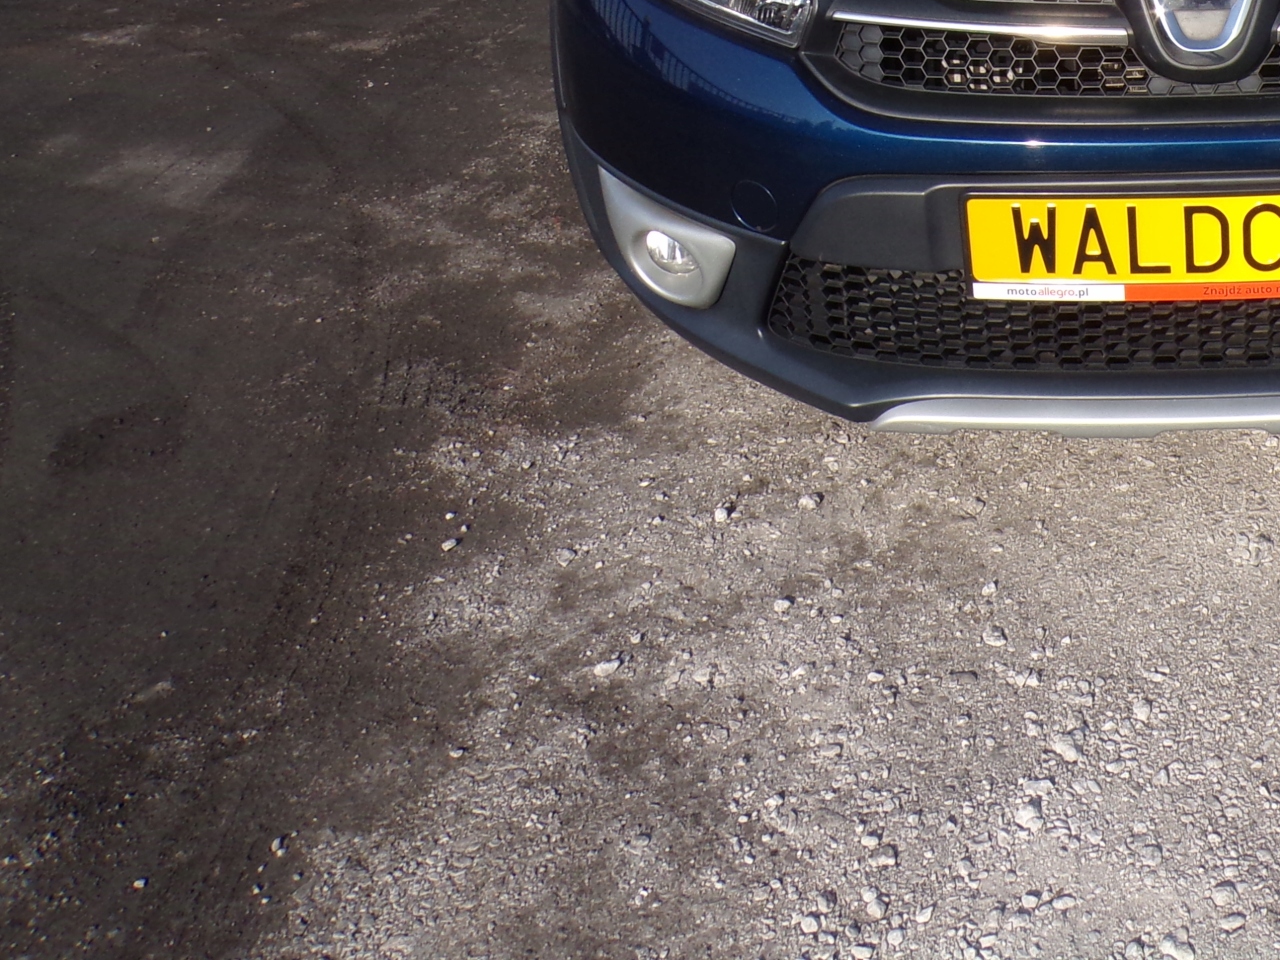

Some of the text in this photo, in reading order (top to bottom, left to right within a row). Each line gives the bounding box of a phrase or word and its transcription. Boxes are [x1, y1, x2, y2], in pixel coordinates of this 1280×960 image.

[1007, 286, 1089, 299] motoallegro.pl
[1203, 285, 1242, 297] Znajdź
[1245, 285, 1272, 294] auto
